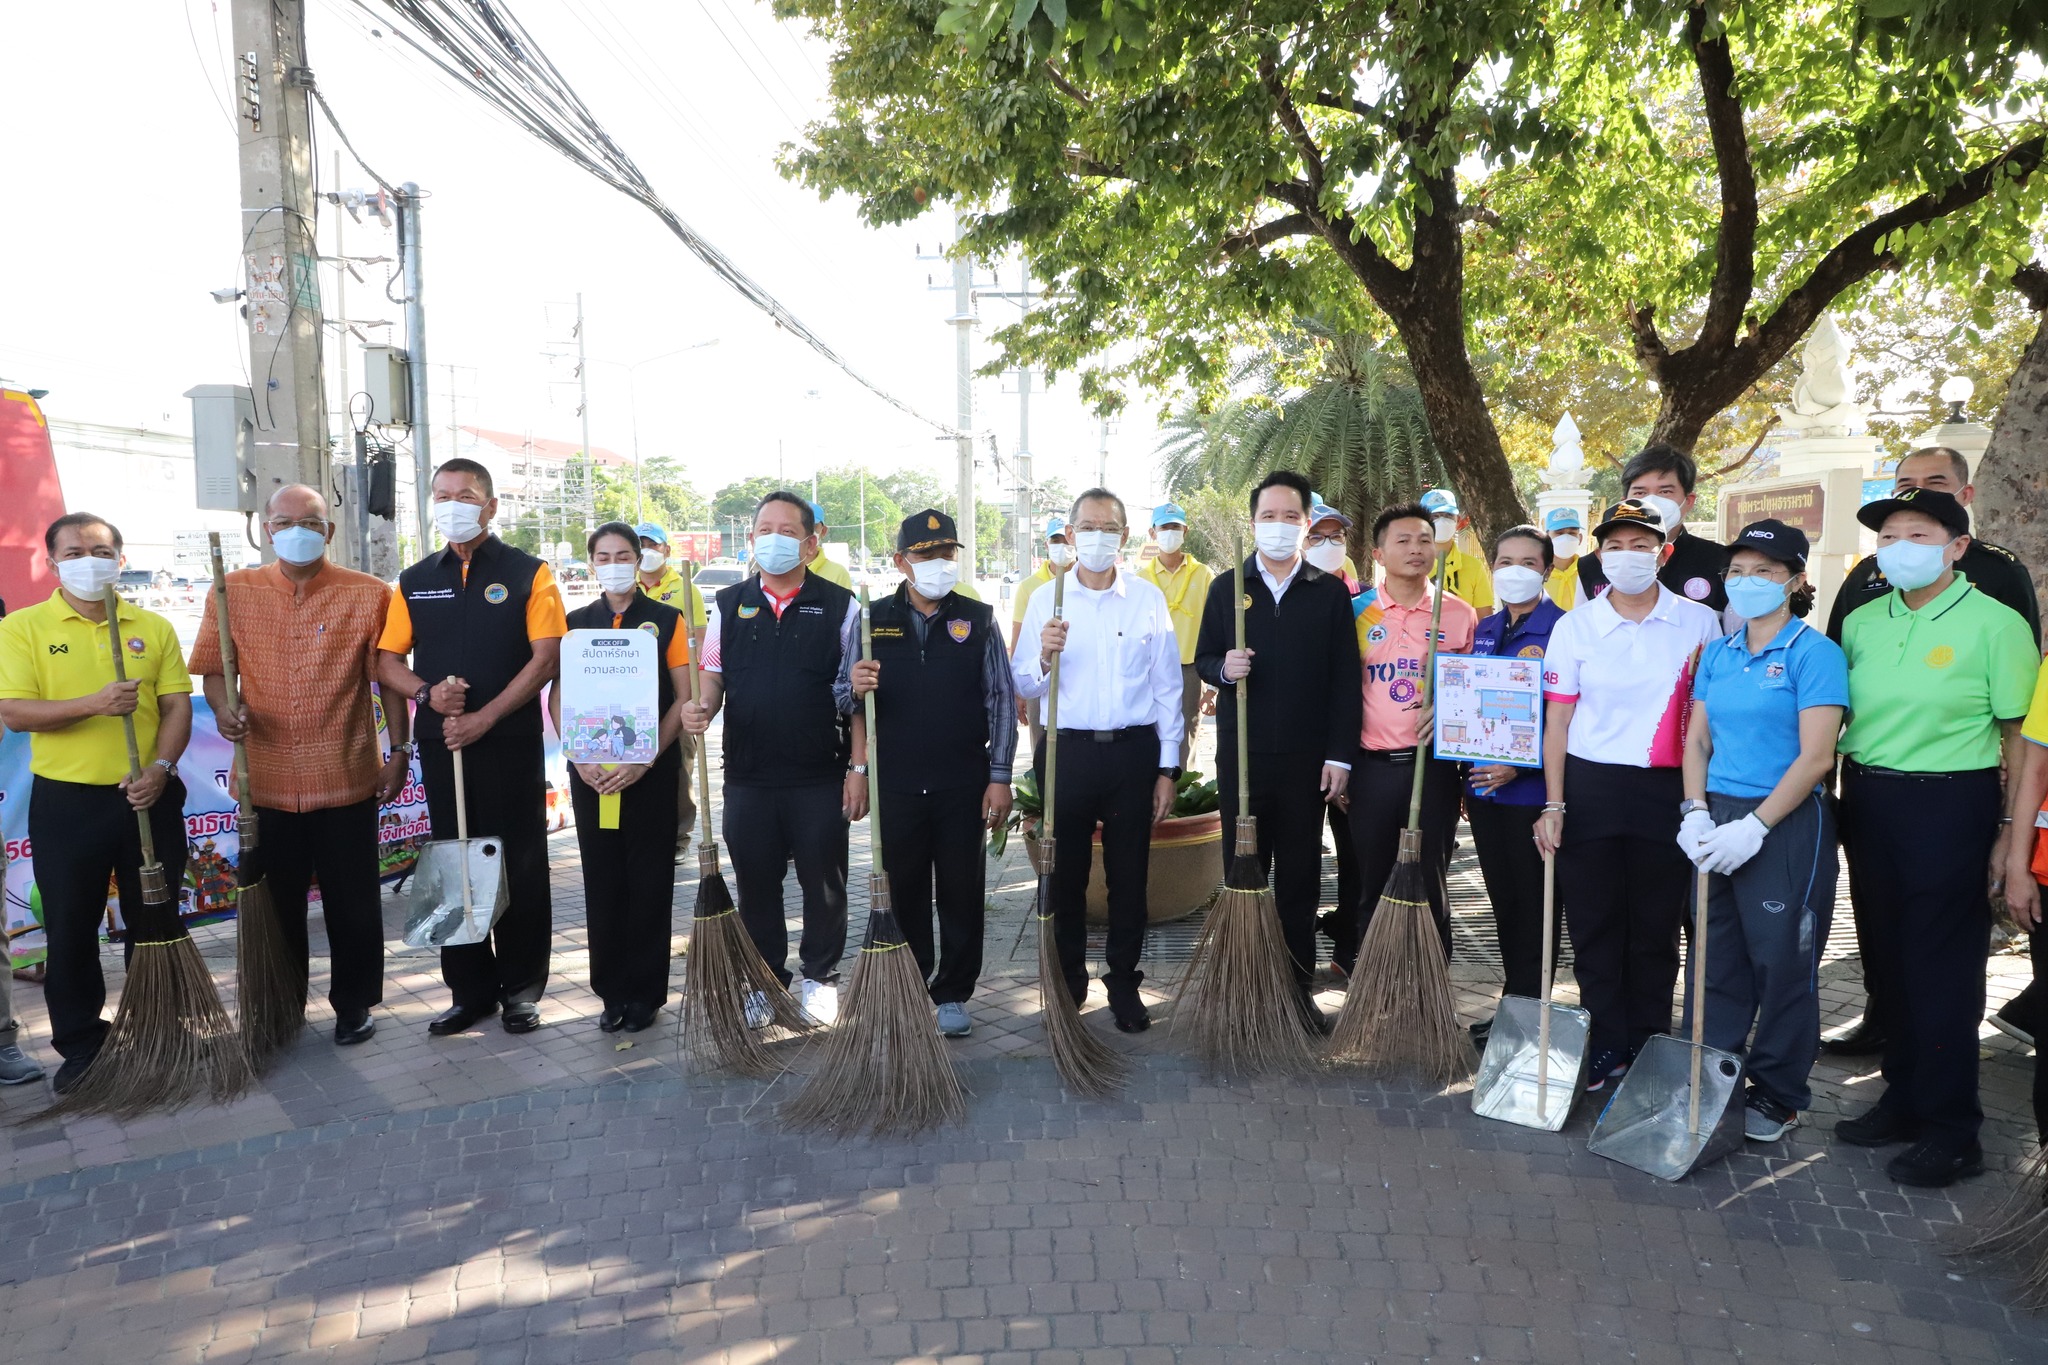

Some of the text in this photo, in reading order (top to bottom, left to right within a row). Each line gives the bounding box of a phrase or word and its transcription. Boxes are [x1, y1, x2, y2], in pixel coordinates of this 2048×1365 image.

[1746, 530, 1775, 539] NSO
[581, 648, 640, 659] สัปดาห์รักษา
[584, 666, 638, 674] ความสะอาด
[1367, 658, 1419, 684] TO BE
[188, 813, 238, 836] มธา
